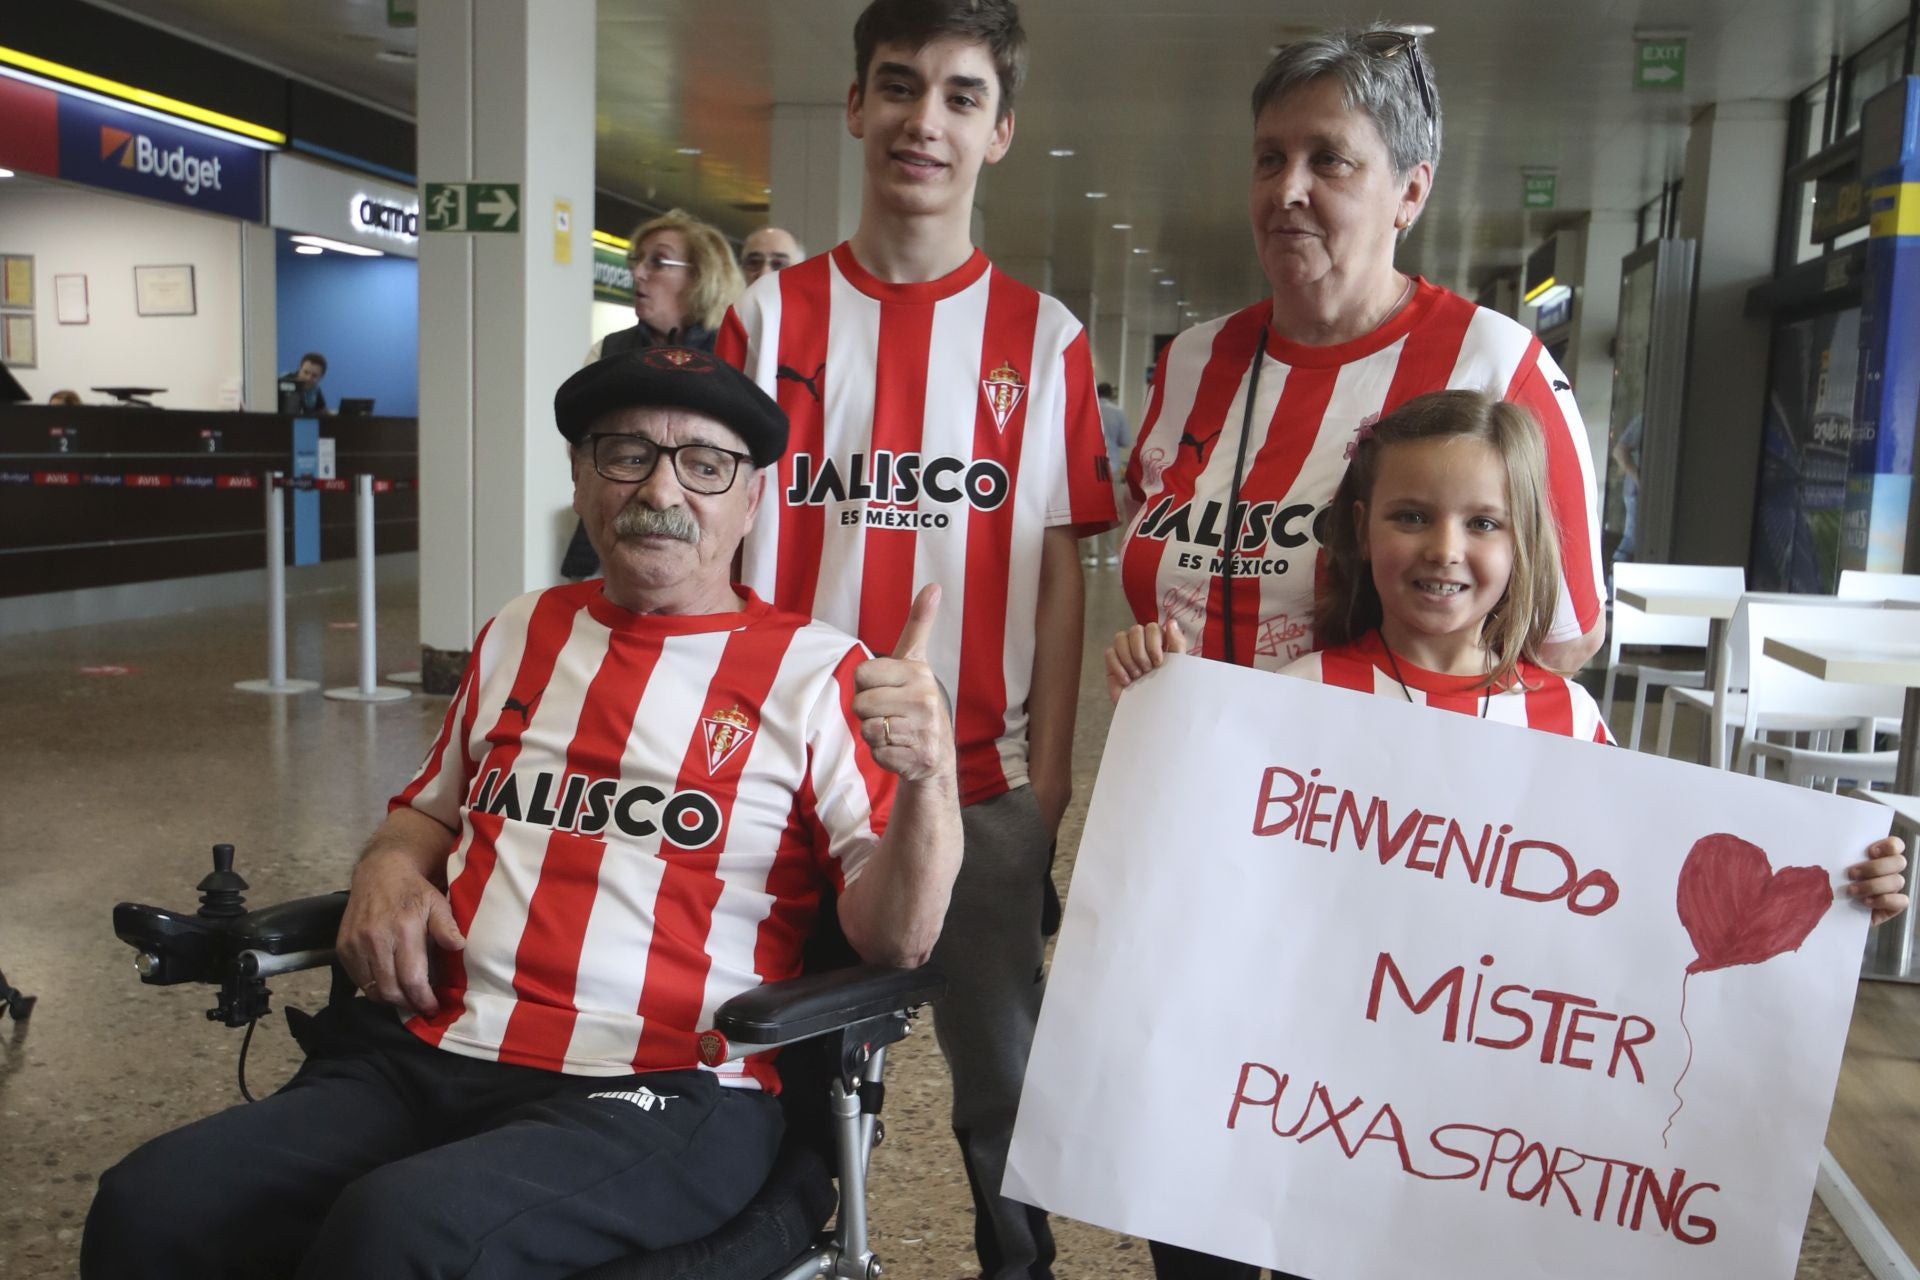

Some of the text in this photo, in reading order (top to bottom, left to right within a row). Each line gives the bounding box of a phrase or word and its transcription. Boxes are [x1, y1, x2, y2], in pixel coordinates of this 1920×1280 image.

[1642, 46, 1682, 60] EXIT
[136, 134, 222, 196] Budget
[138, 475, 161, 487] AVIS
[229, 477, 252, 487] AVIS
[787, 451, 1009, 511] JALISCO
[840, 507, 949, 528] ES MÉXICO
[1178, 553, 1202, 571] ES
[472, 769, 720, 848] JALISCO
